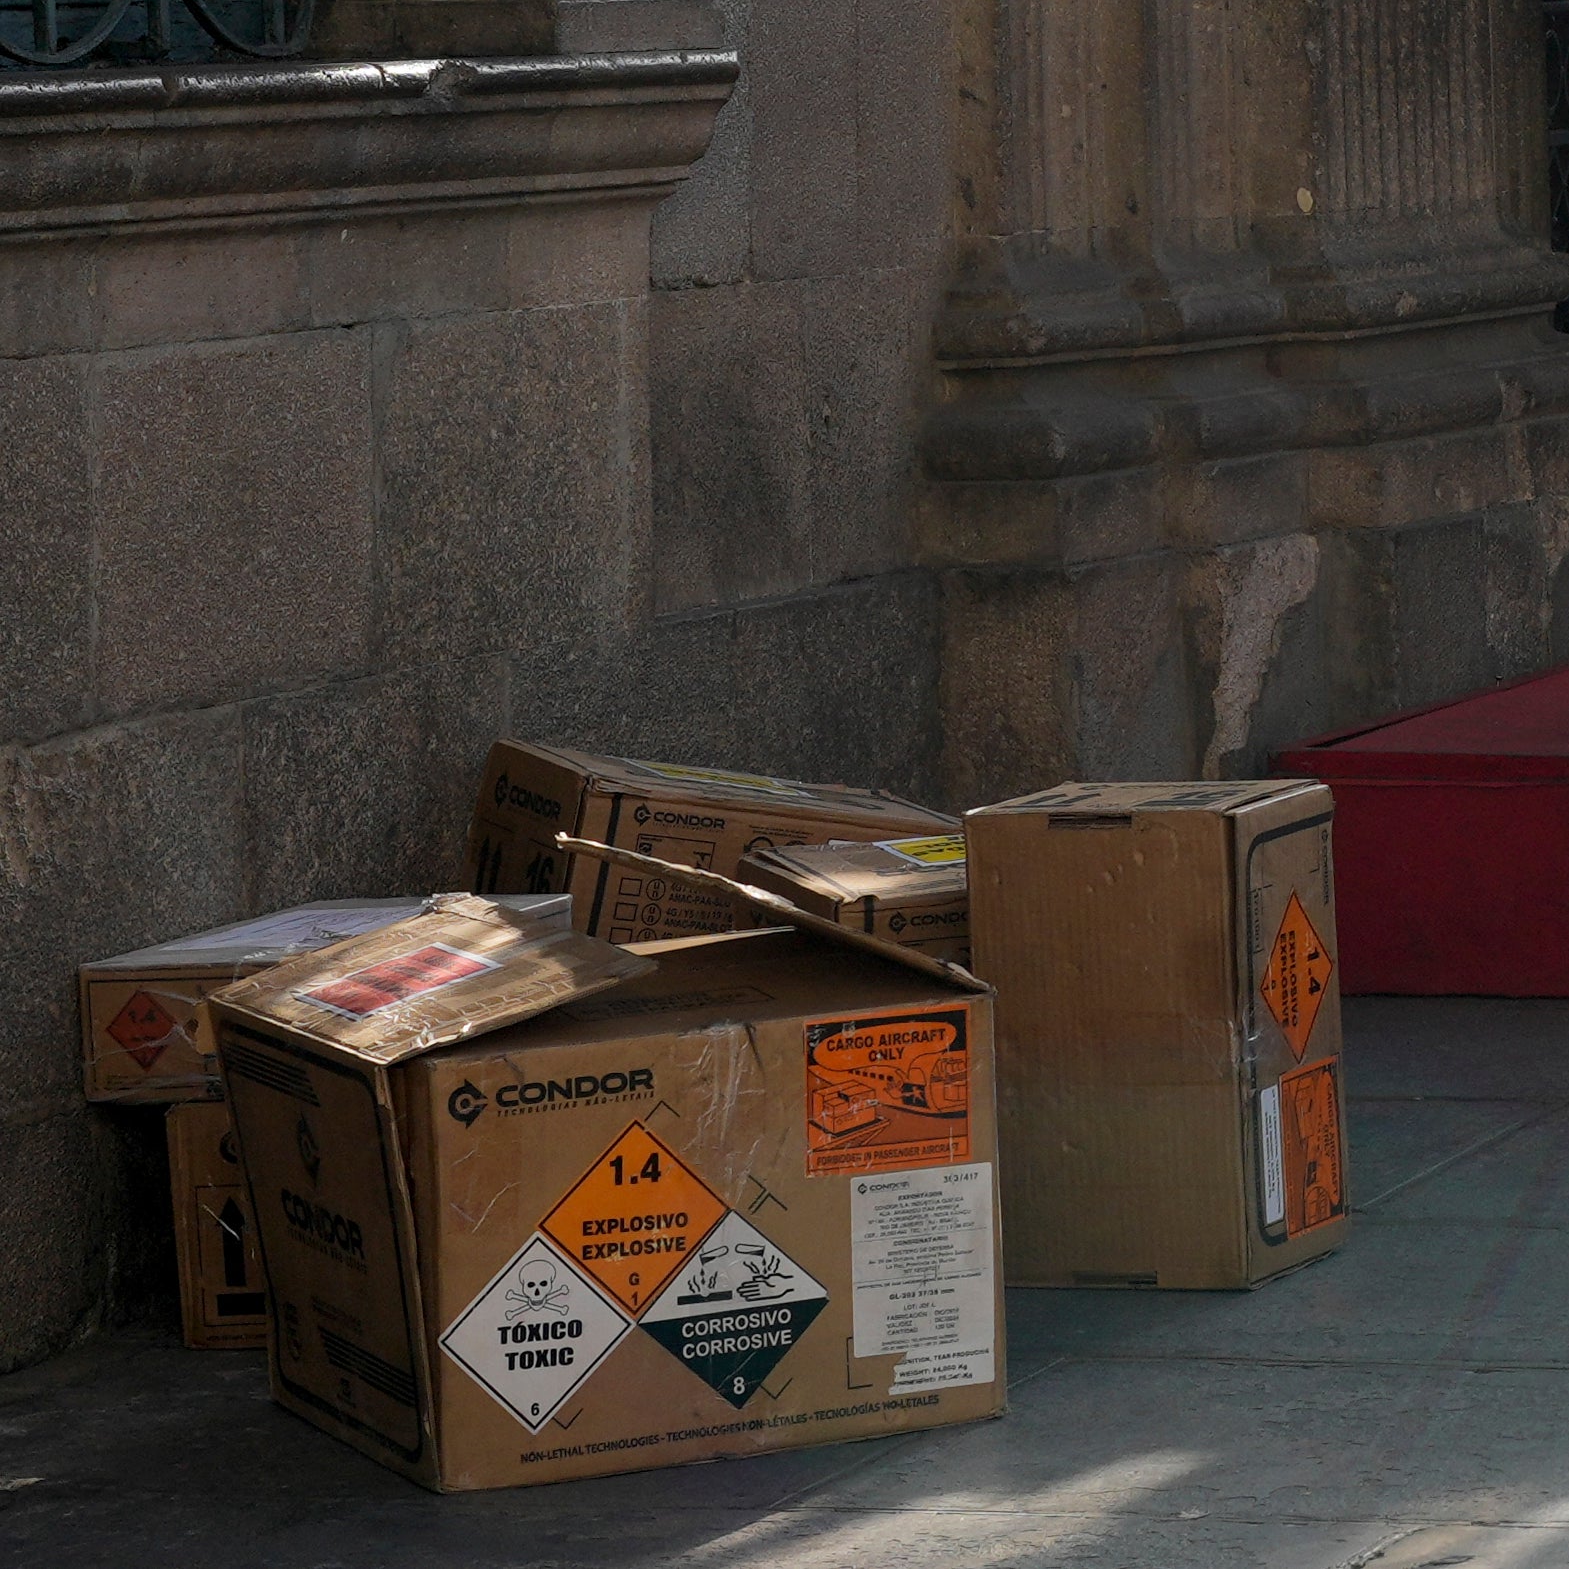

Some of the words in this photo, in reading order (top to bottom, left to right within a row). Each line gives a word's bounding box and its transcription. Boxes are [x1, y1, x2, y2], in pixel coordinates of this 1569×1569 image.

[510, 785, 561, 821] CONDOR
[654, 812, 725, 828] CONDOR
[1280, 933, 1289, 1029] EXPLOSIVE
[1288, 931, 1298, 1027] EXPLOSIVO
[1307, 947, 1321, 996] 1.4
[827, 1037, 874, 1052] CARGO
[878, 1028, 946, 1047] AIRCRAFT
[868, 1047, 905, 1062] ONLY
[496, 1068, 655, 1108] CONDOR
[874, 1147, 920, 1160] PASSENGER
[922, 1143, 959, 1155] AIRCRAFT
[609, 1152, 662, 1186] 1.4
[280, 1188, 366, 1260] CONDOR
[582, 1212, 689, 1236] EXPLOSIVO
[582, 1236, 687, 1261] EXPLOSIVE
[629, 1272, 640, 1287] G
[631, 1292, 639, 1307] 1
[497, 1318, 583, 1346] TÓXICO
[681, 1309, 792, 1339] CORROSIVO
[682, 1329, 793, 1361] CORROSIVE
[505, 1347, 575, 1372] TOXIC
[733, 1376, 746, 1396] 8
[531, 1403, 540, 1417] 6
[520, 1446, 584, 1464] NON-LETHAL
[584, 1435, 659, 1455] TECHNOLOGIES
[814, 1402, 880, 1421] TECNOLOGÍAS
